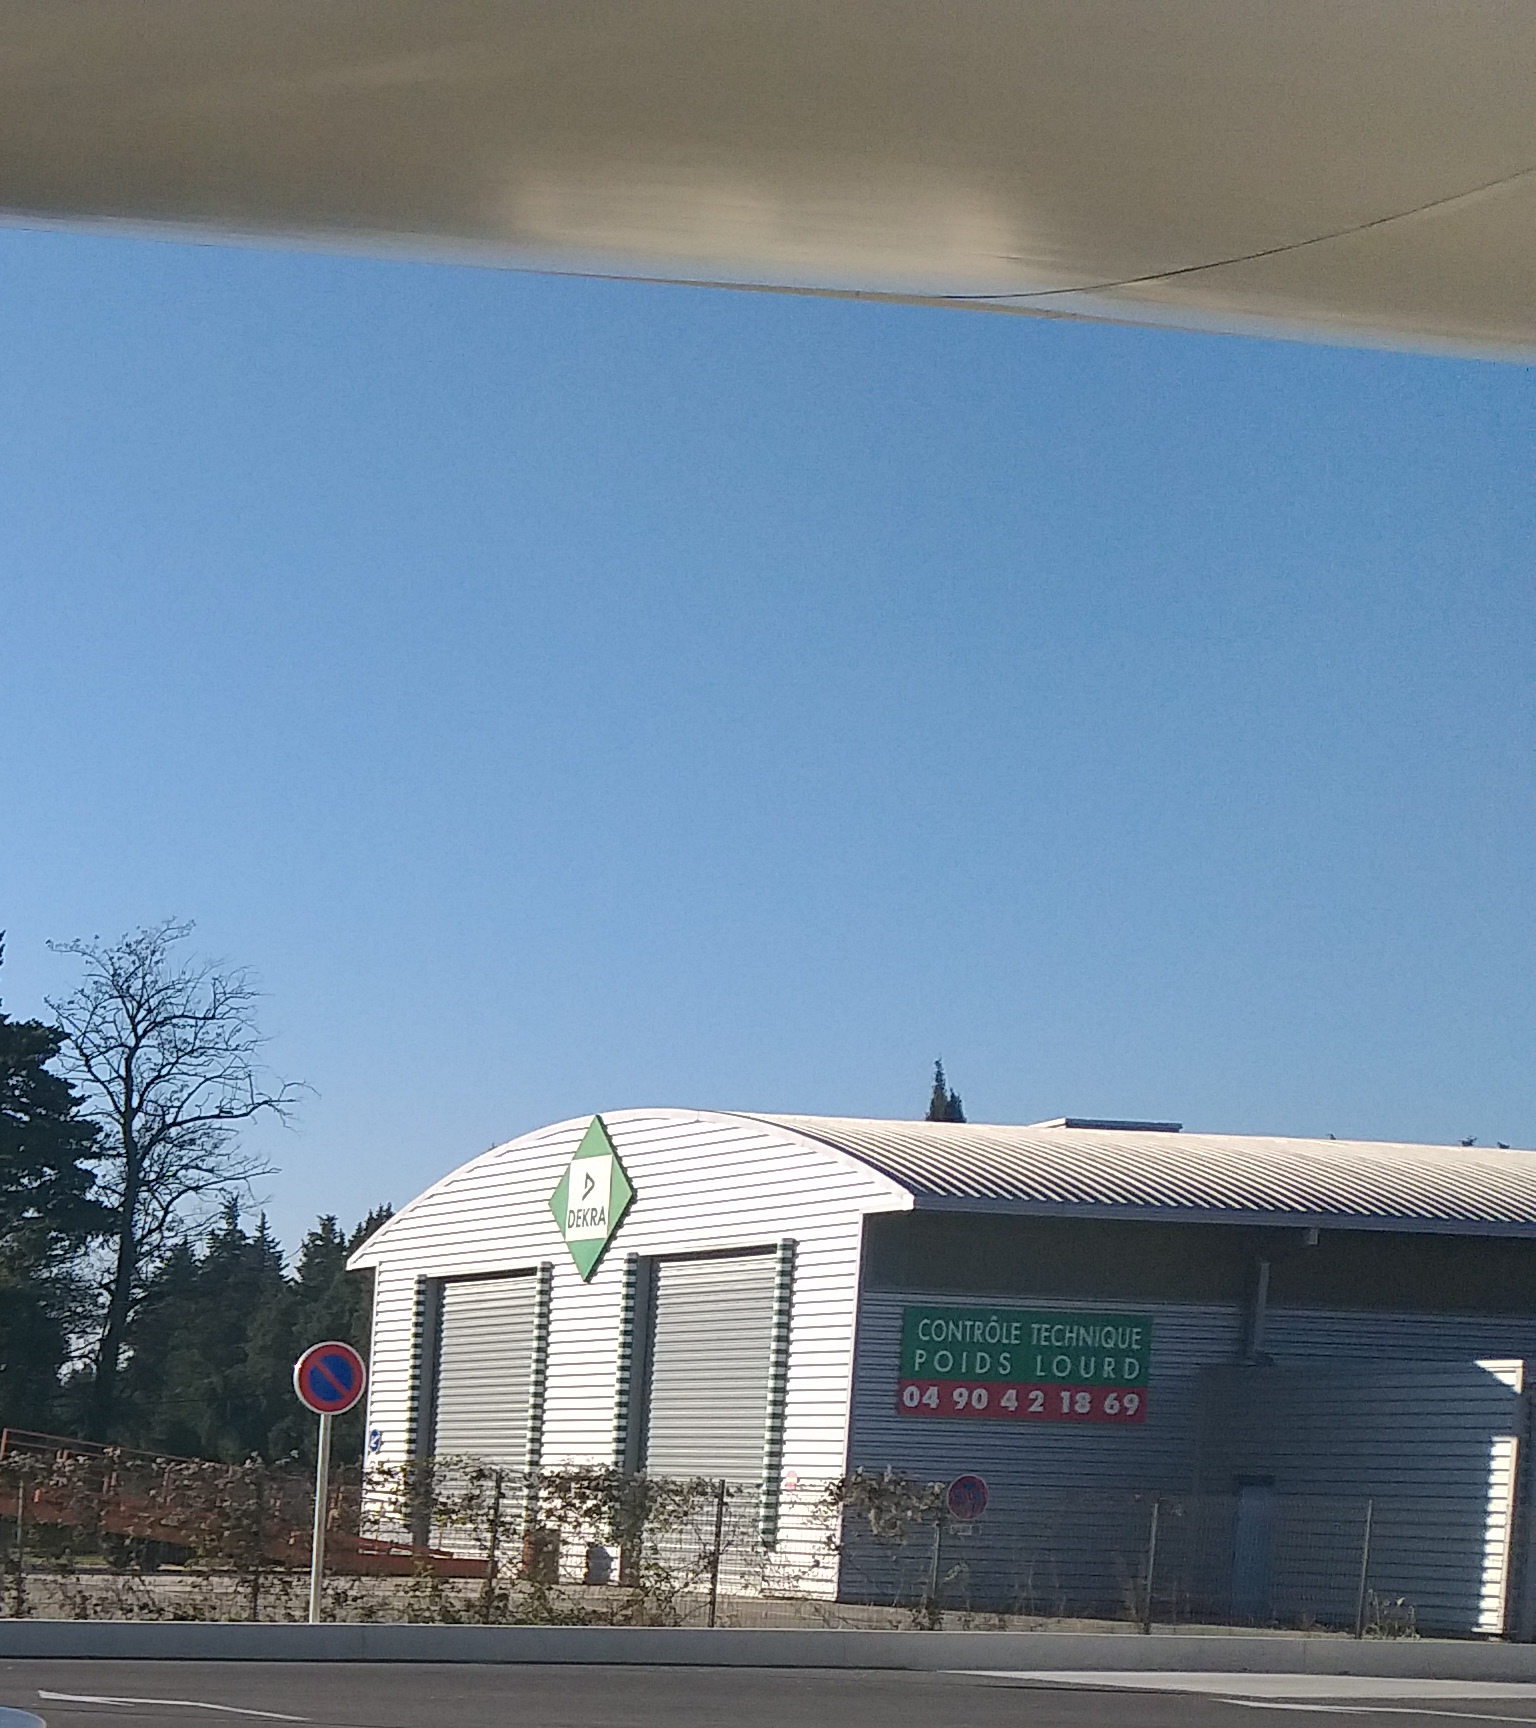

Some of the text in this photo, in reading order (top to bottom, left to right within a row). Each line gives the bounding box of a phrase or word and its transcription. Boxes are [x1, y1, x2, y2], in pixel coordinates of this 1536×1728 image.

[567, 1205, 607, 1229] DEKRA
[918, 1315, 1142, 1349] CONTRÔLE TECHNIQUE
[914, 1350, 1140, 1380] POIDS LOURD
[903, 1385, 940, 1409] 04
[952, 1388, 988, 1410] 90
[1060, 1391, 1091, 1414] 18
[1103, 1393, 1139, 1416] 69
